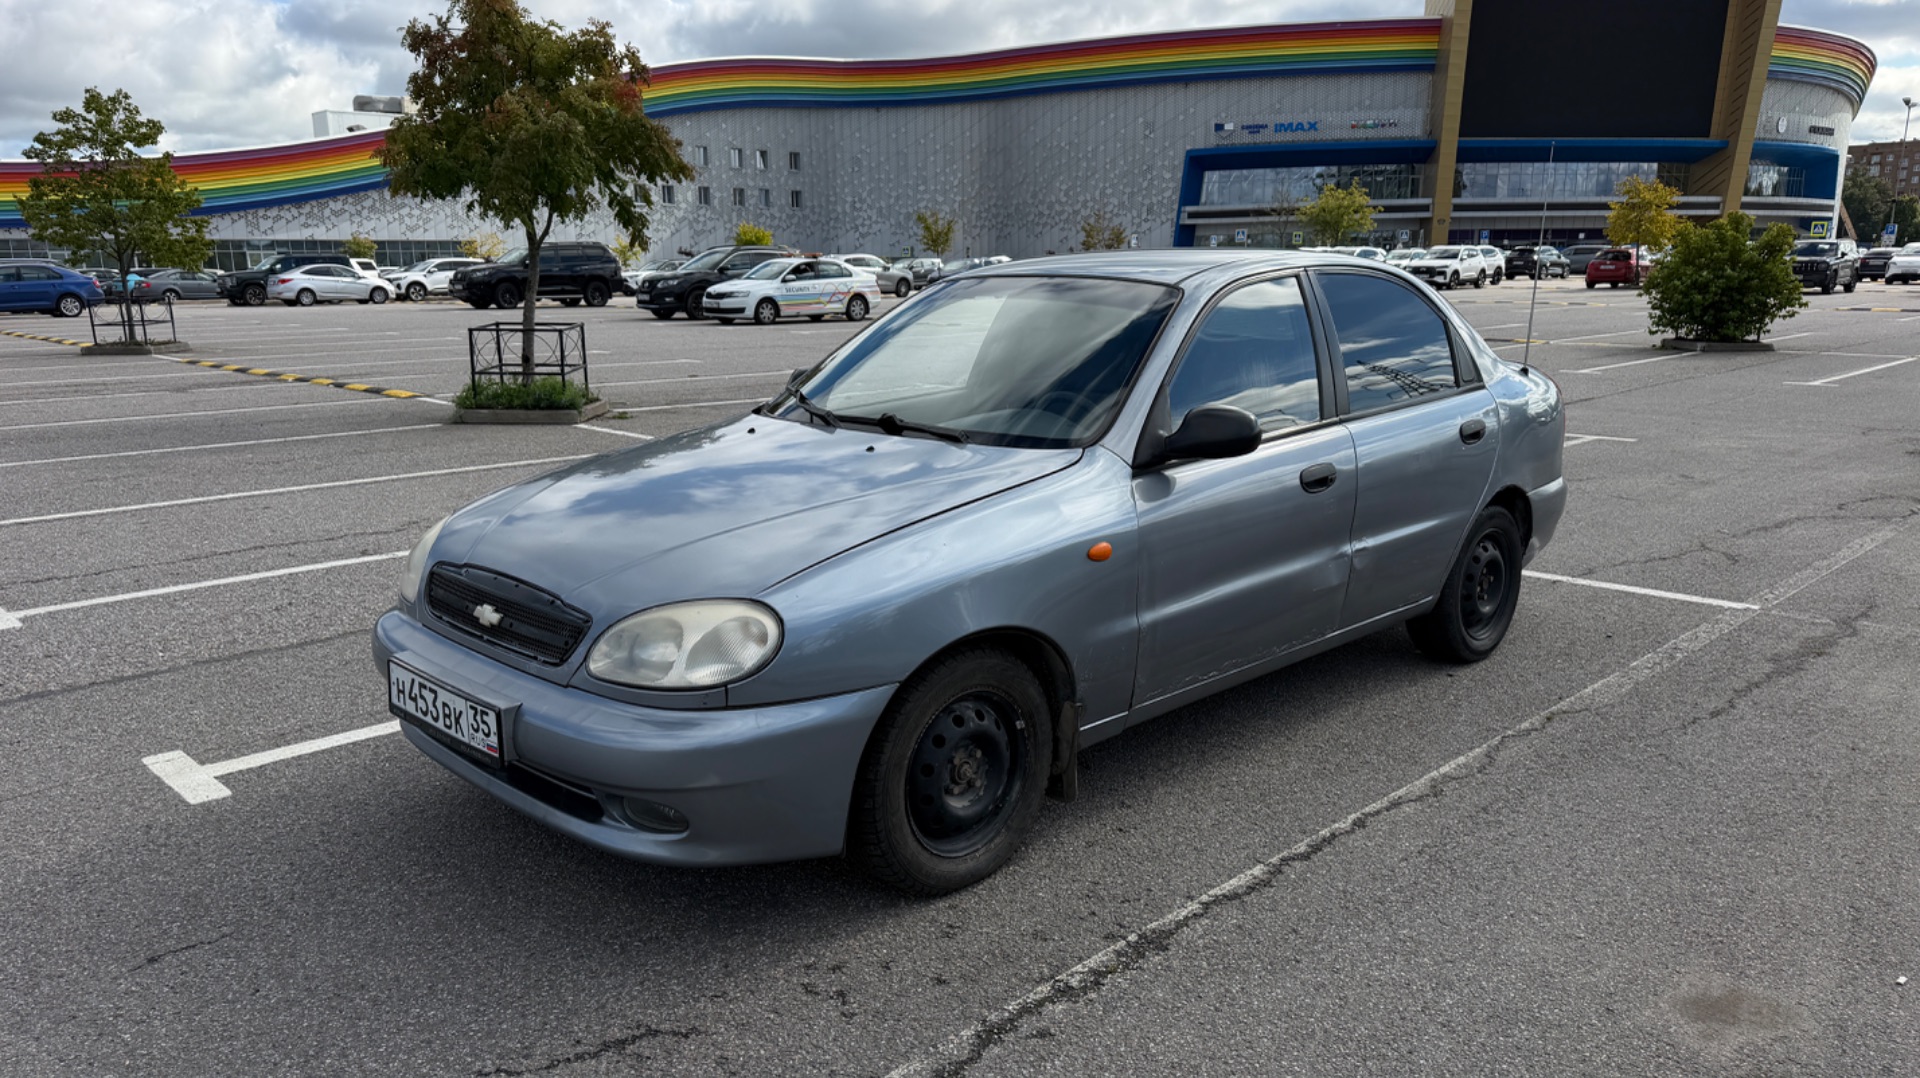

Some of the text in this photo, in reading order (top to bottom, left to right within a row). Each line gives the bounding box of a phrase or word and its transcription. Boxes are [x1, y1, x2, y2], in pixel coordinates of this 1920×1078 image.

[1274, 121, 1319, 133] IMAX
[396, 677, 491, 739] Н453ВК 35
[471, 732, 487, 749] RUS
